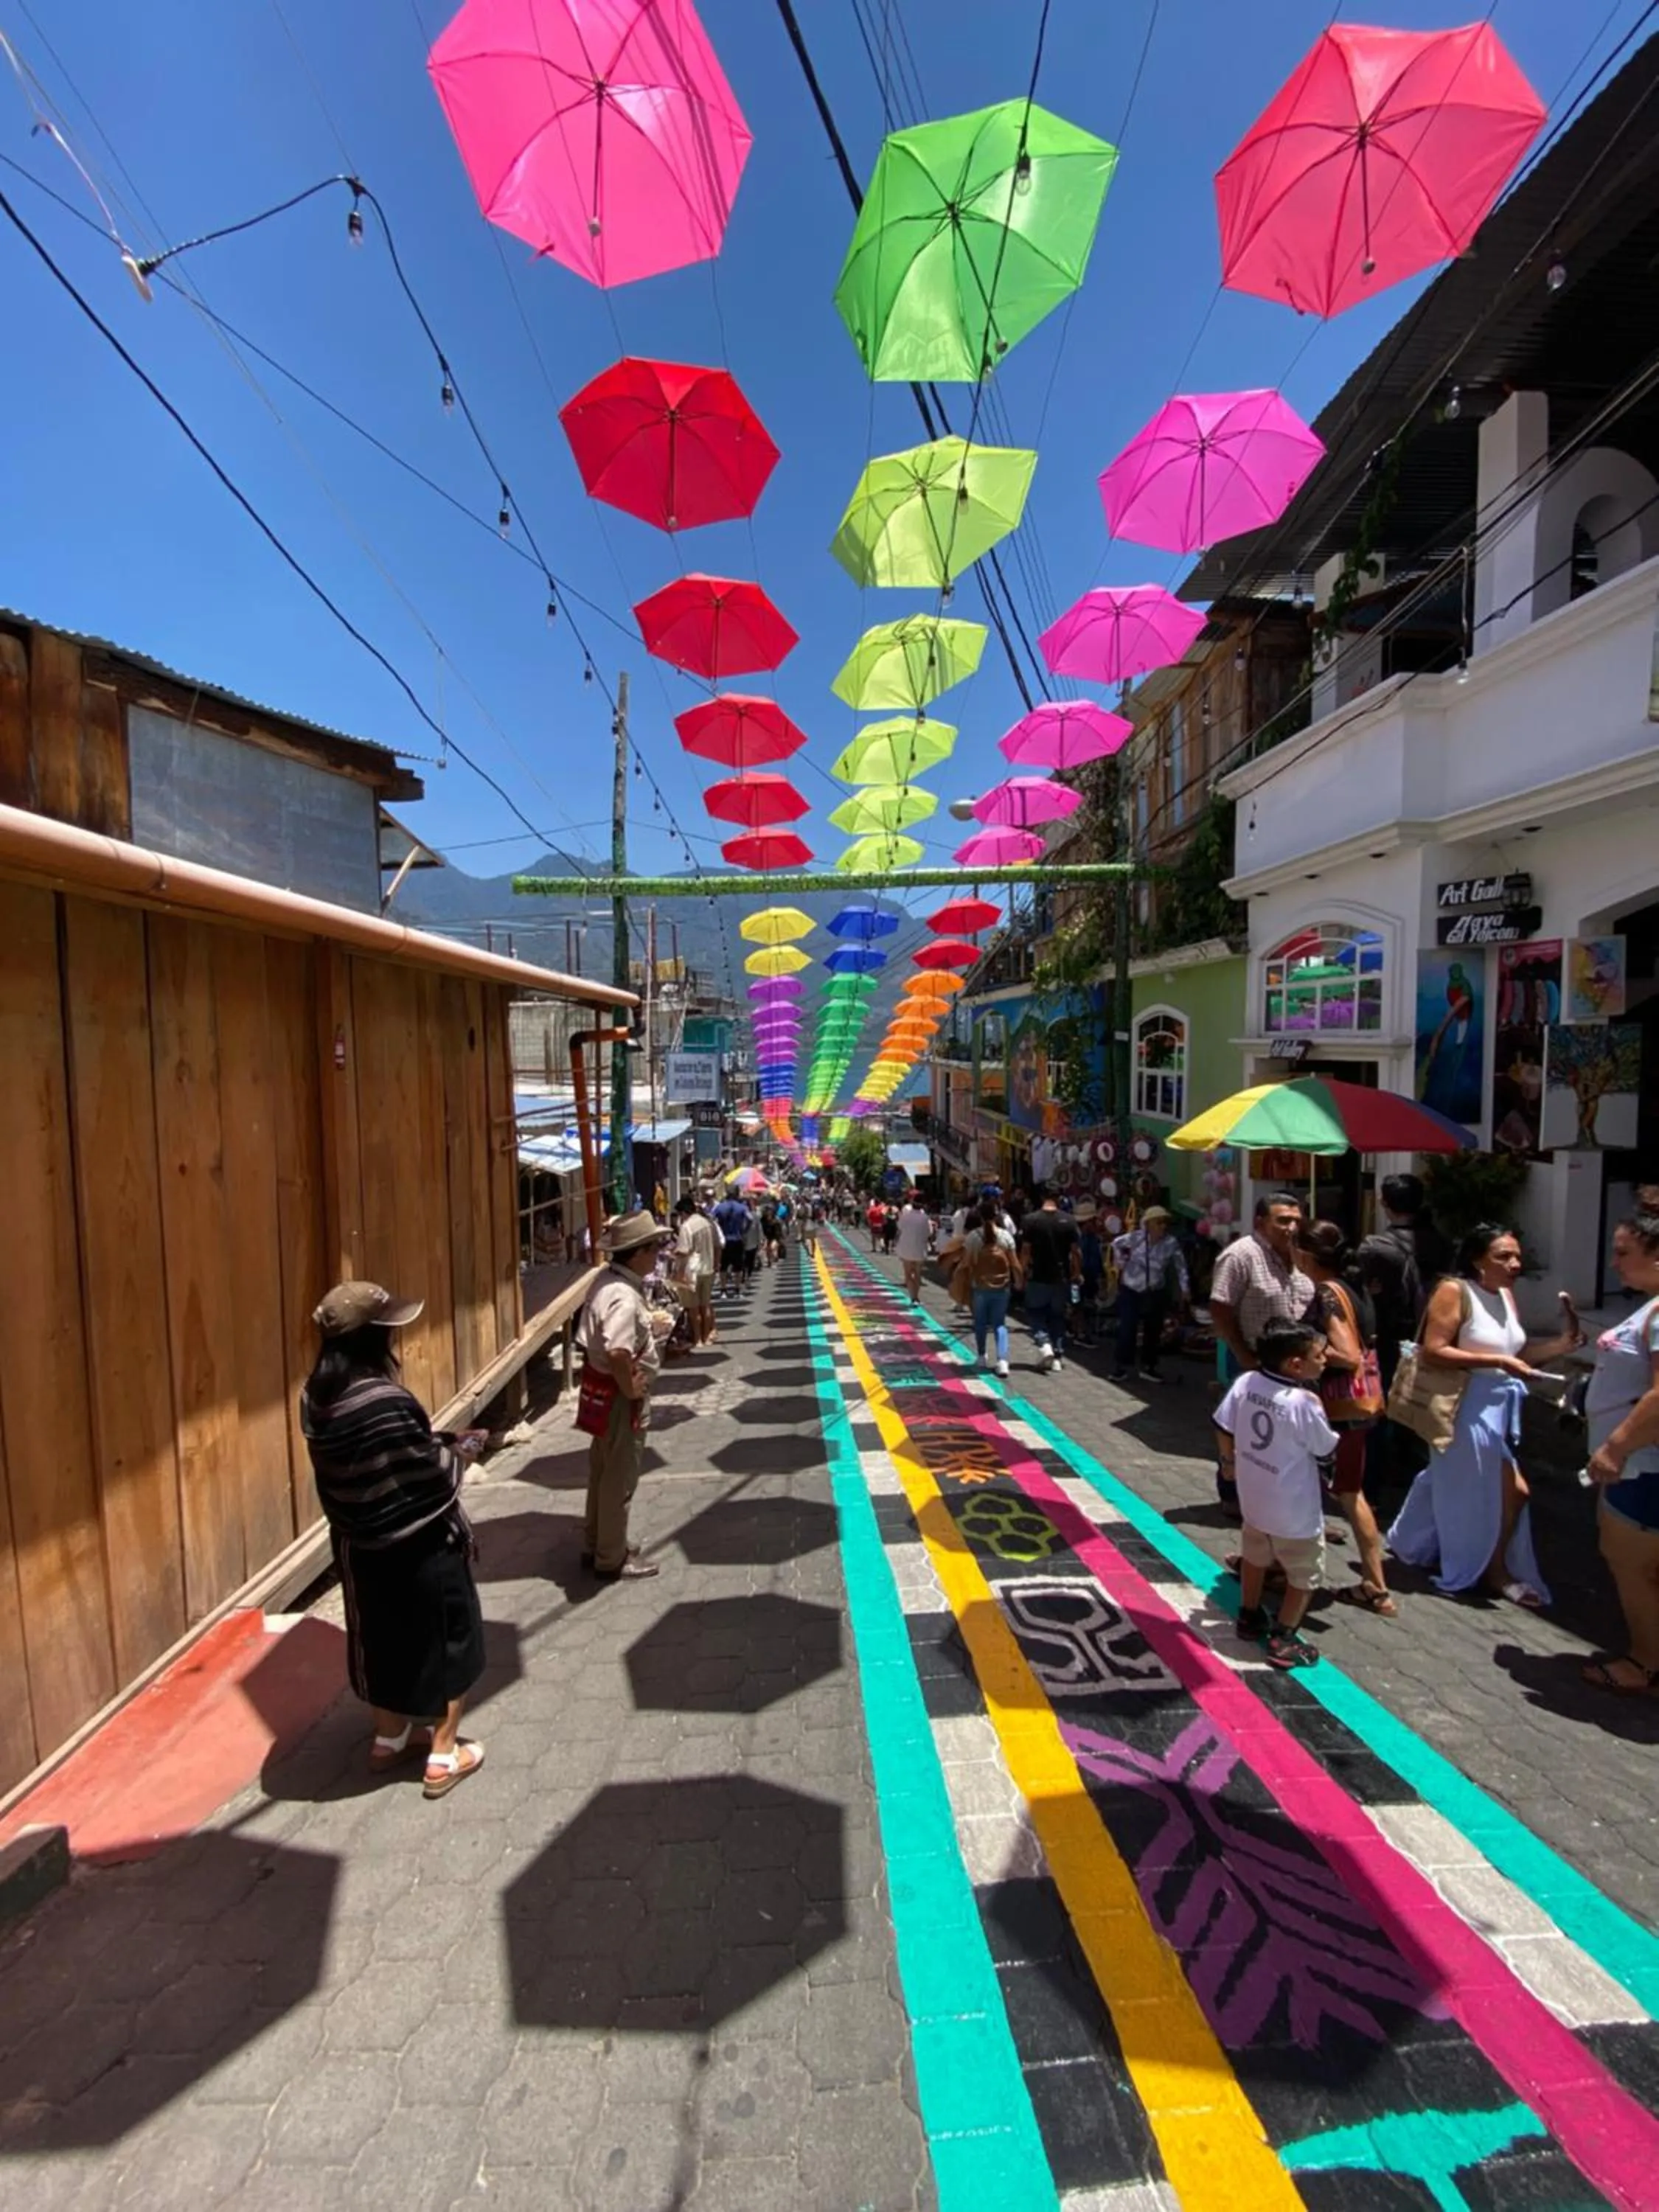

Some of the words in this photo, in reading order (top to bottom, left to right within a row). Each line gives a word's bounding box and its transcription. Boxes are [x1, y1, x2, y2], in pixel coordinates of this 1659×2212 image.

[1439, 882, 1469, 905] Art
[1454, 914, 1505, 931] Maya
[1251, 1411, 1274, 1451] 9
